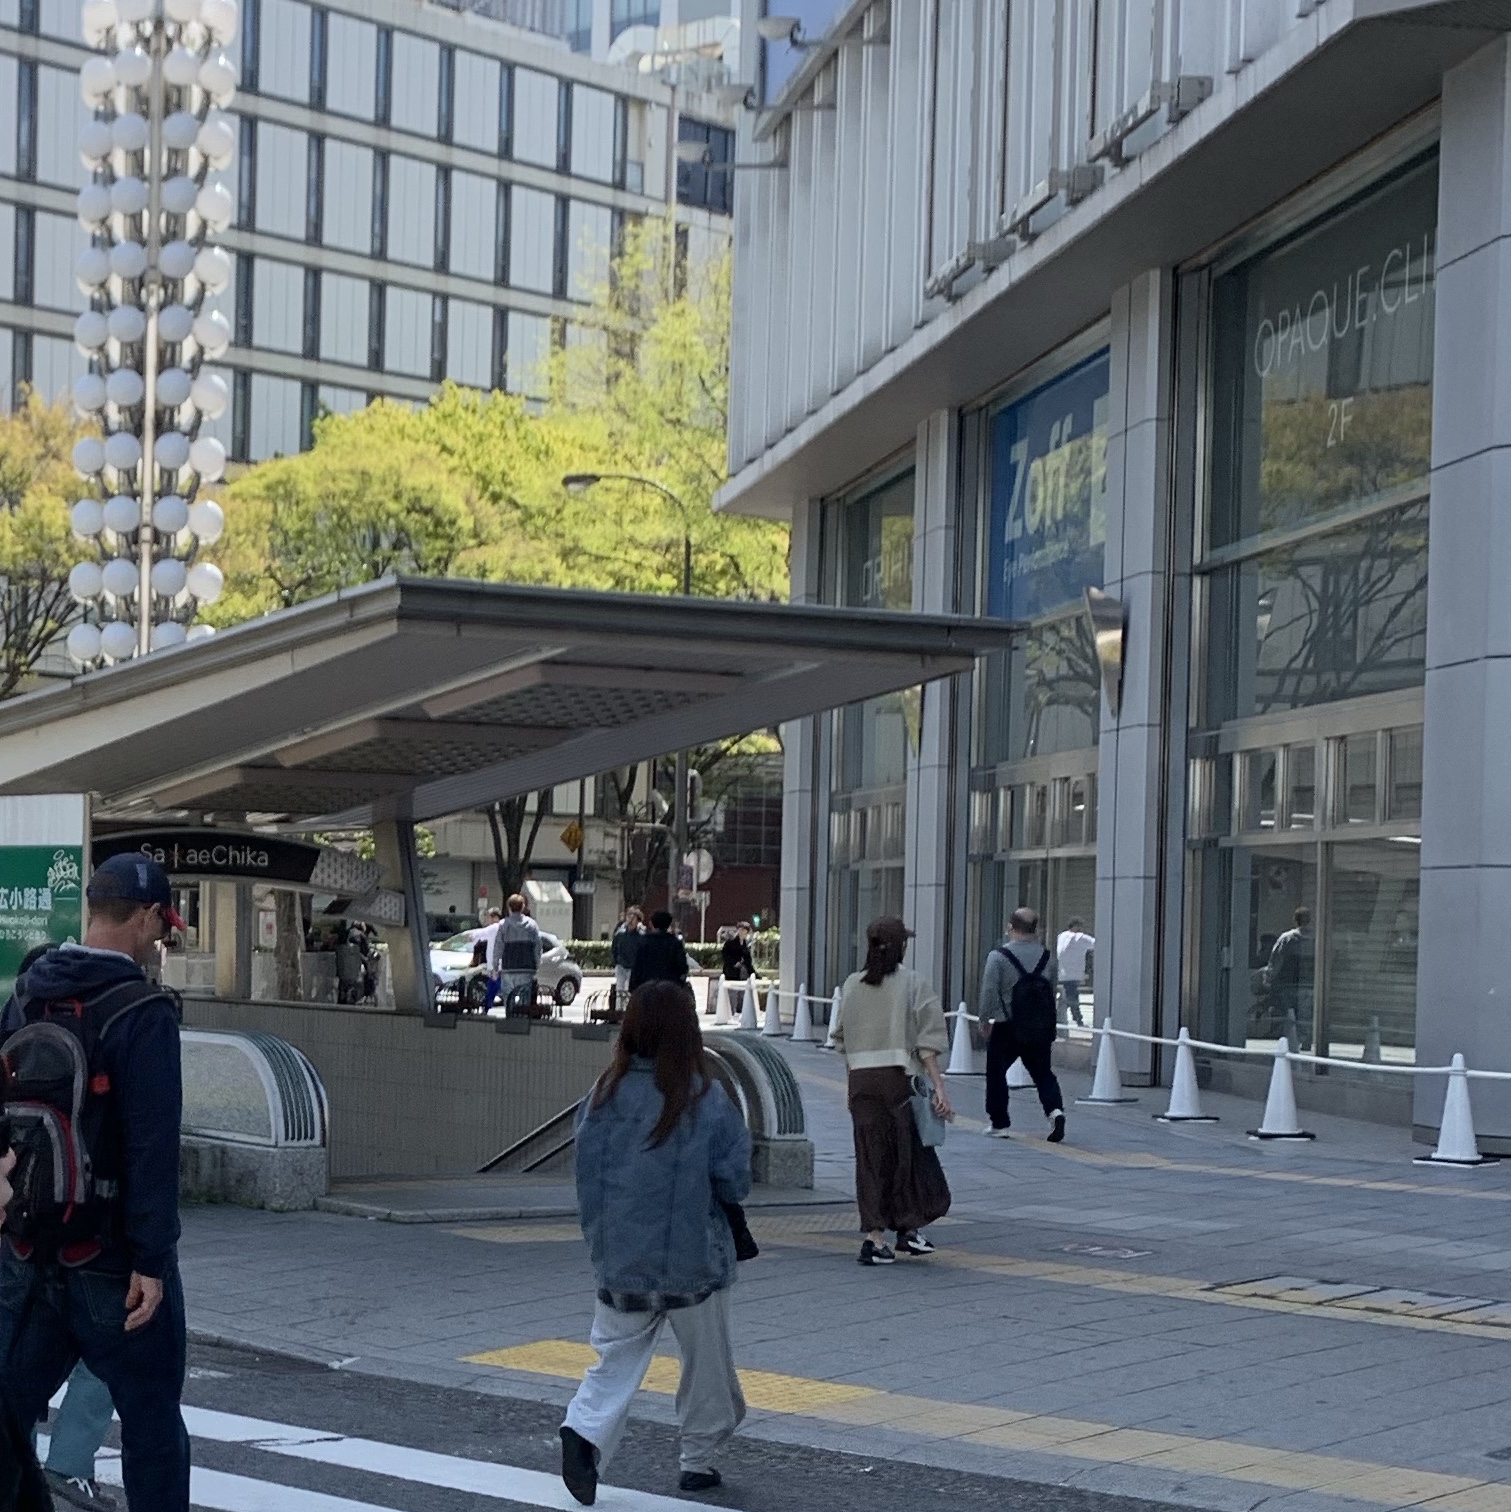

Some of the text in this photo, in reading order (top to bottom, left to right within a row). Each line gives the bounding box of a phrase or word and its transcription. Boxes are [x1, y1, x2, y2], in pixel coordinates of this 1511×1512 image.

[1254, 231, 1436, 379] OPAQUE.CLI
[1004, 412, 1074, 545] Zoff
[1326, 397, 1355, 448] 2F
